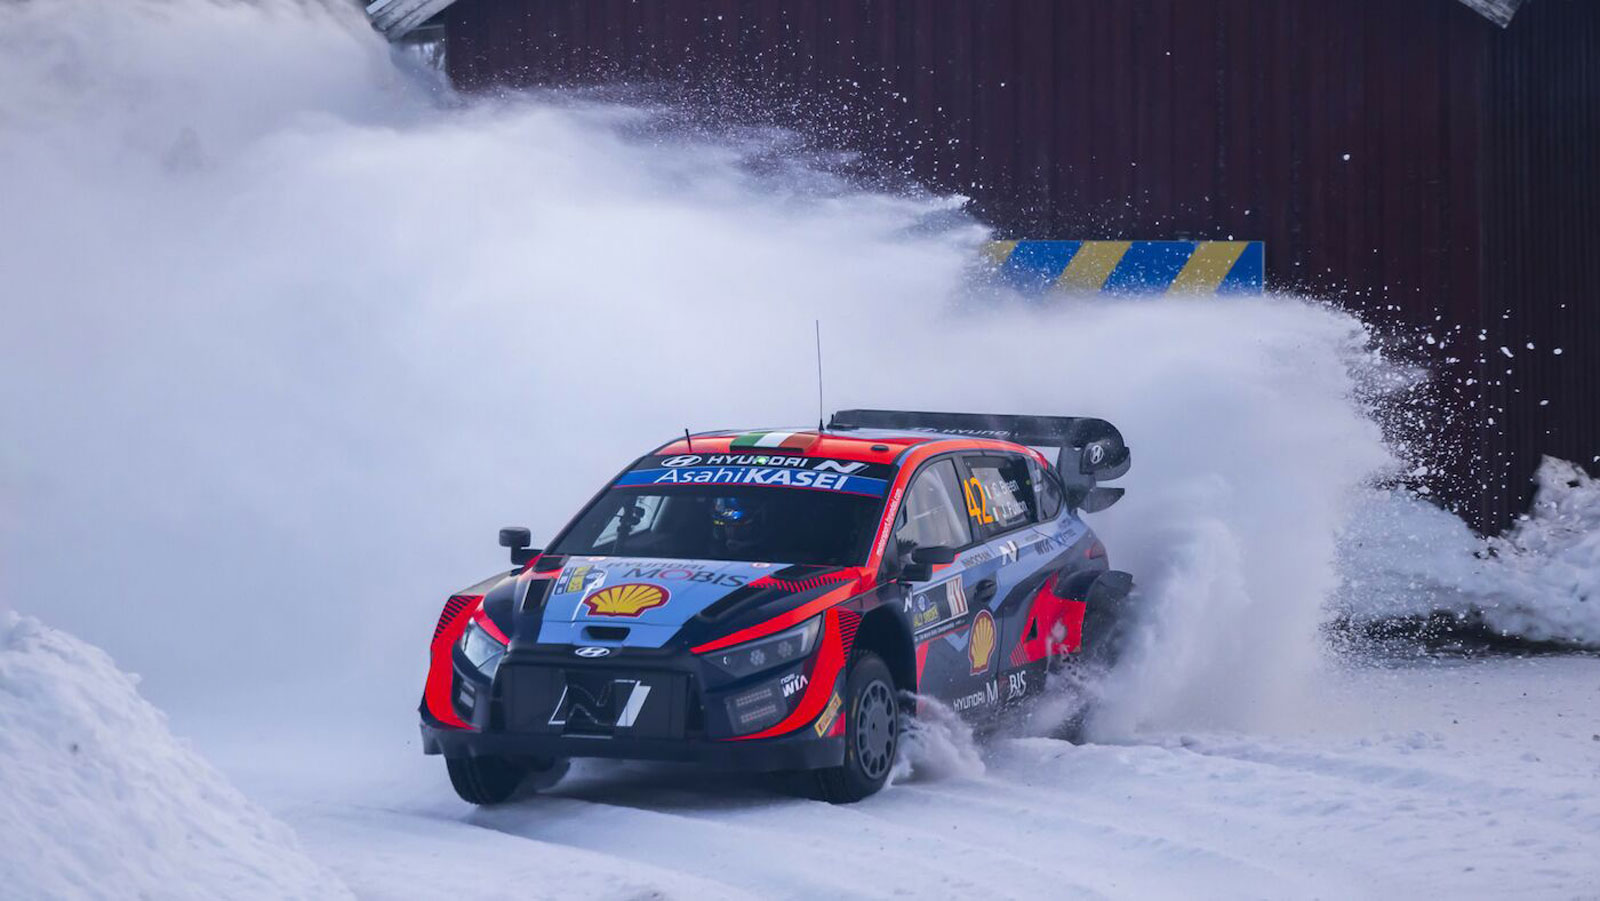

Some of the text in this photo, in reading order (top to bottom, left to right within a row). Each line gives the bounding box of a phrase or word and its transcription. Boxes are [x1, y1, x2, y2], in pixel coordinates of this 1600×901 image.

[706, 454, 808, 467] HYUNDAI
[963, 477, 993, 526] 42
[621, 567, 749, 588] MOBIS
[782, 674, 808, 697] WIA
[953, 690, 985, 713] HYUNDAI
